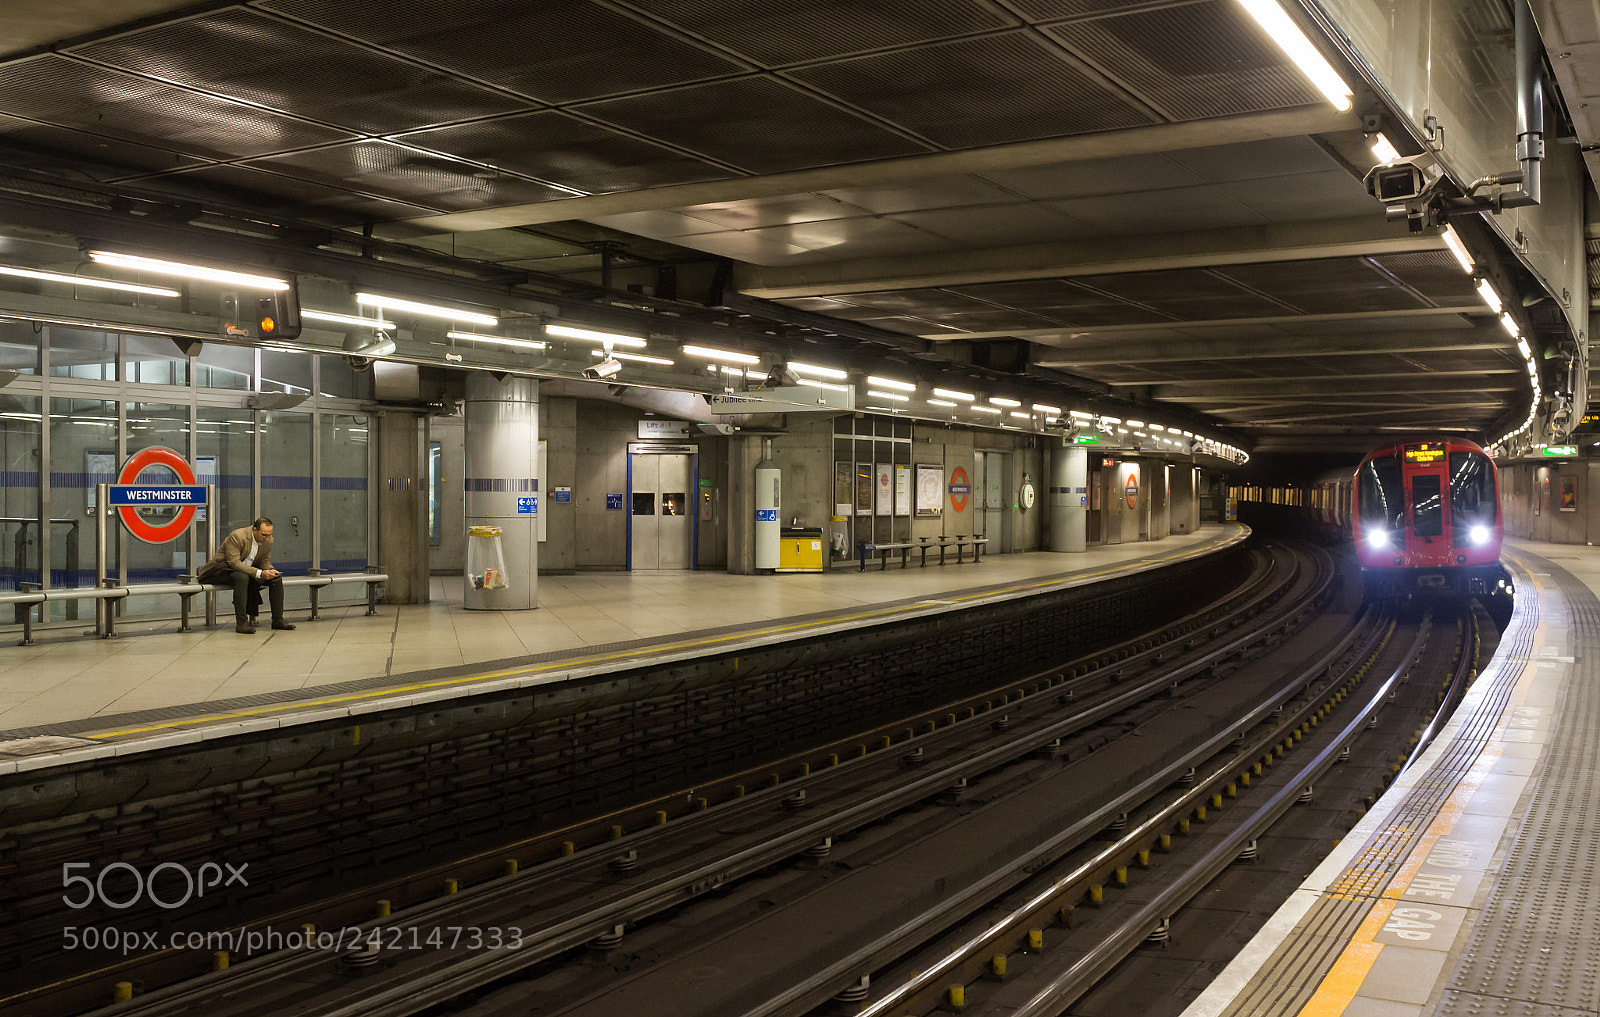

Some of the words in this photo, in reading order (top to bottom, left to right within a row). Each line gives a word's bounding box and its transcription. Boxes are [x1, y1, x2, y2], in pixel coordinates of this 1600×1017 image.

[721, 395, 746, 403] Jubilee
[126, 490, 192, 500] WESTMINSTER
[1405, 872, 1462, 900] THE
[1382, 907, 1442, 941] GAP
